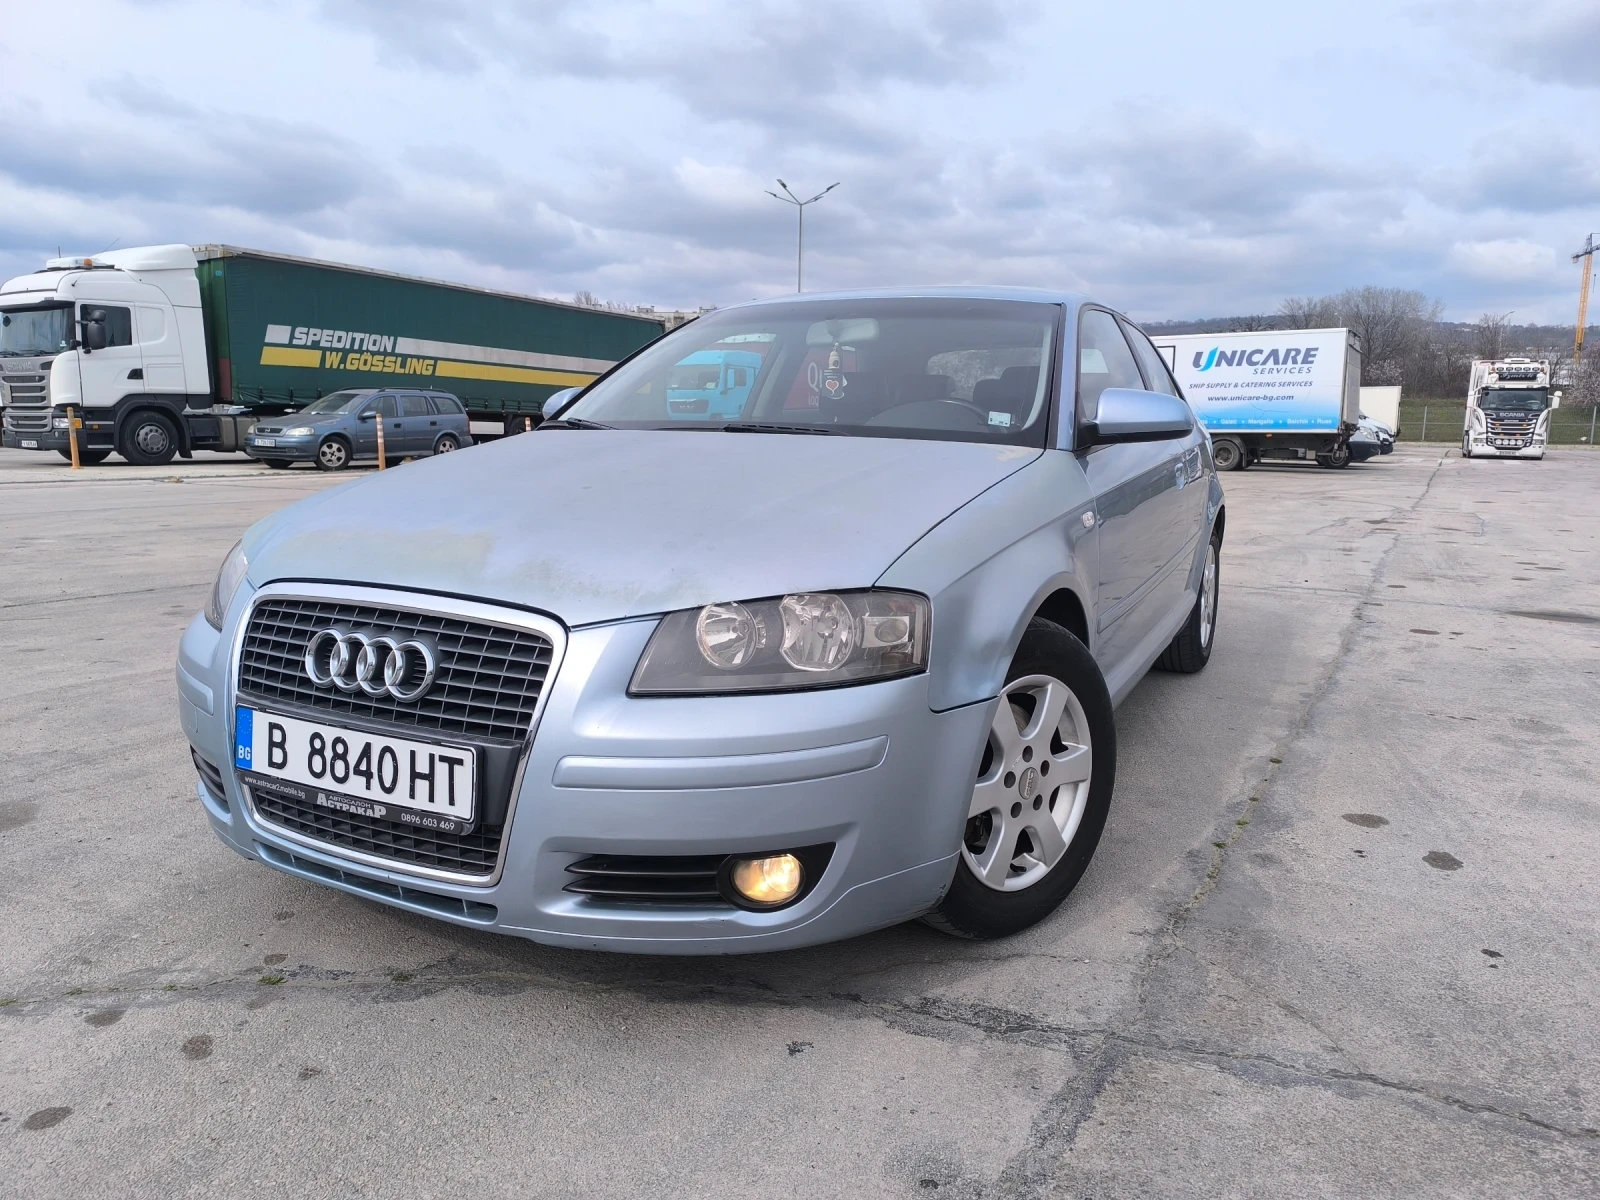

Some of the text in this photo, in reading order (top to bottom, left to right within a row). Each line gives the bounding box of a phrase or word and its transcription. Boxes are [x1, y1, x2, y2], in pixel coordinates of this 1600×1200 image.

[292, 327, 394, 353] SPEDITION
[325, 351, 435, 376] W.GÖSSLING
[1192, 346, 1319, 372] UNICARE
[1252, 366, 1313, 375] SERVICES
[1277, 380, 1313, 388] SERVICES
[1207, 394, 1294, 402] www.unicare-bg.com
[238, 745, 251, 761] BG
[267, 721, 465, 807] B 8840 HT
[244, 776, 306, 800] www.astracar2.mobile.bg
[328, 795, 371, 808] АВТОСАЛОН
[401, 812, 455, 831] 0896 603 469
